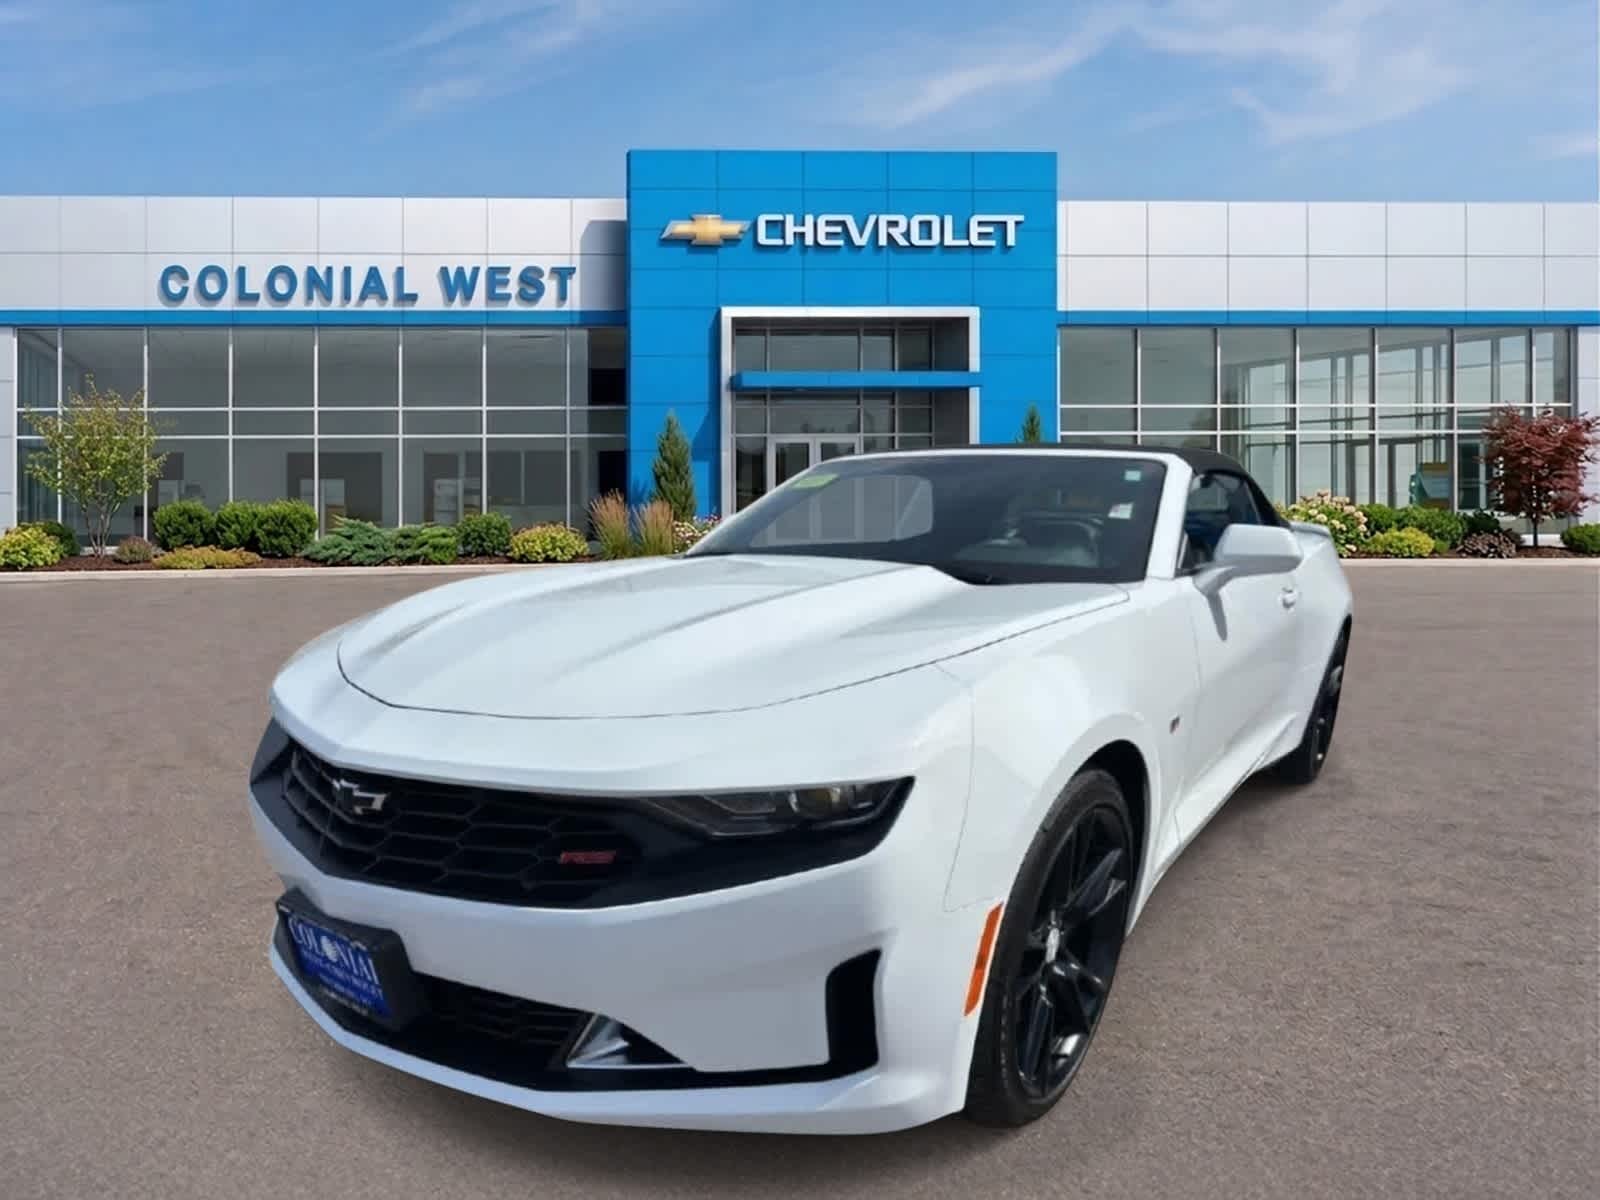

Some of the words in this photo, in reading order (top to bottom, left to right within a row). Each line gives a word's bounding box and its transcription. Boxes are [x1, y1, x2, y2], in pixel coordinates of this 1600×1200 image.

[757, 213, 1025, 247] CHEVROLET
[159, 264, 418, 306] COLONIAL
[438, 266, 576, 306] WEST
